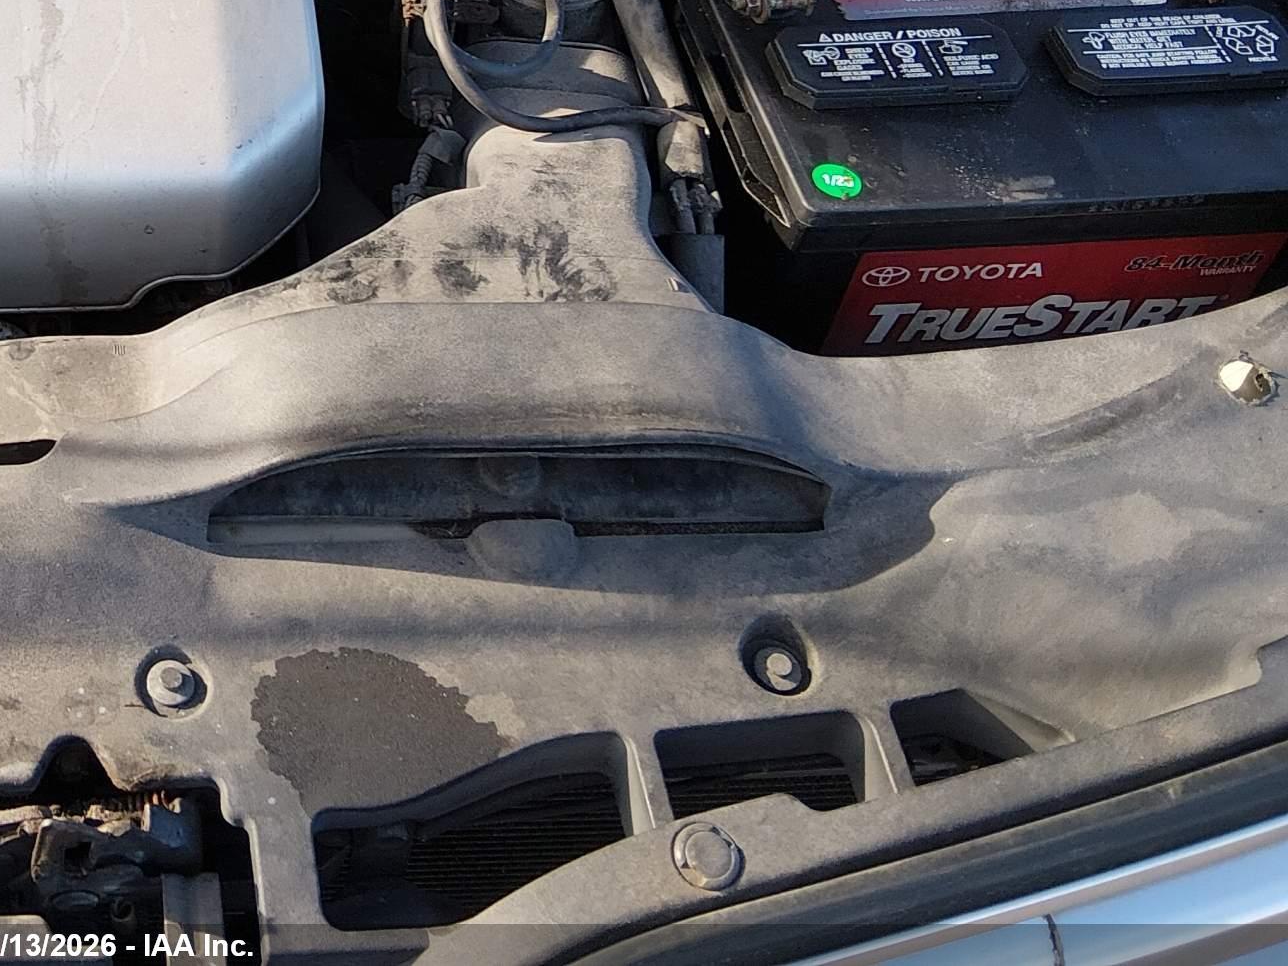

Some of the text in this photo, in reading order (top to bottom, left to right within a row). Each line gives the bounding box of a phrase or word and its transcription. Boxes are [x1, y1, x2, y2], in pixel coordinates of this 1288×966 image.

[834, 32, 893, 43] DANGER
[906, 28, 962, 38] POISON
[918, 250, 1265, 283] TOYOTA 84-Month
[1200, 265, 1257, 276] WARRANTY
